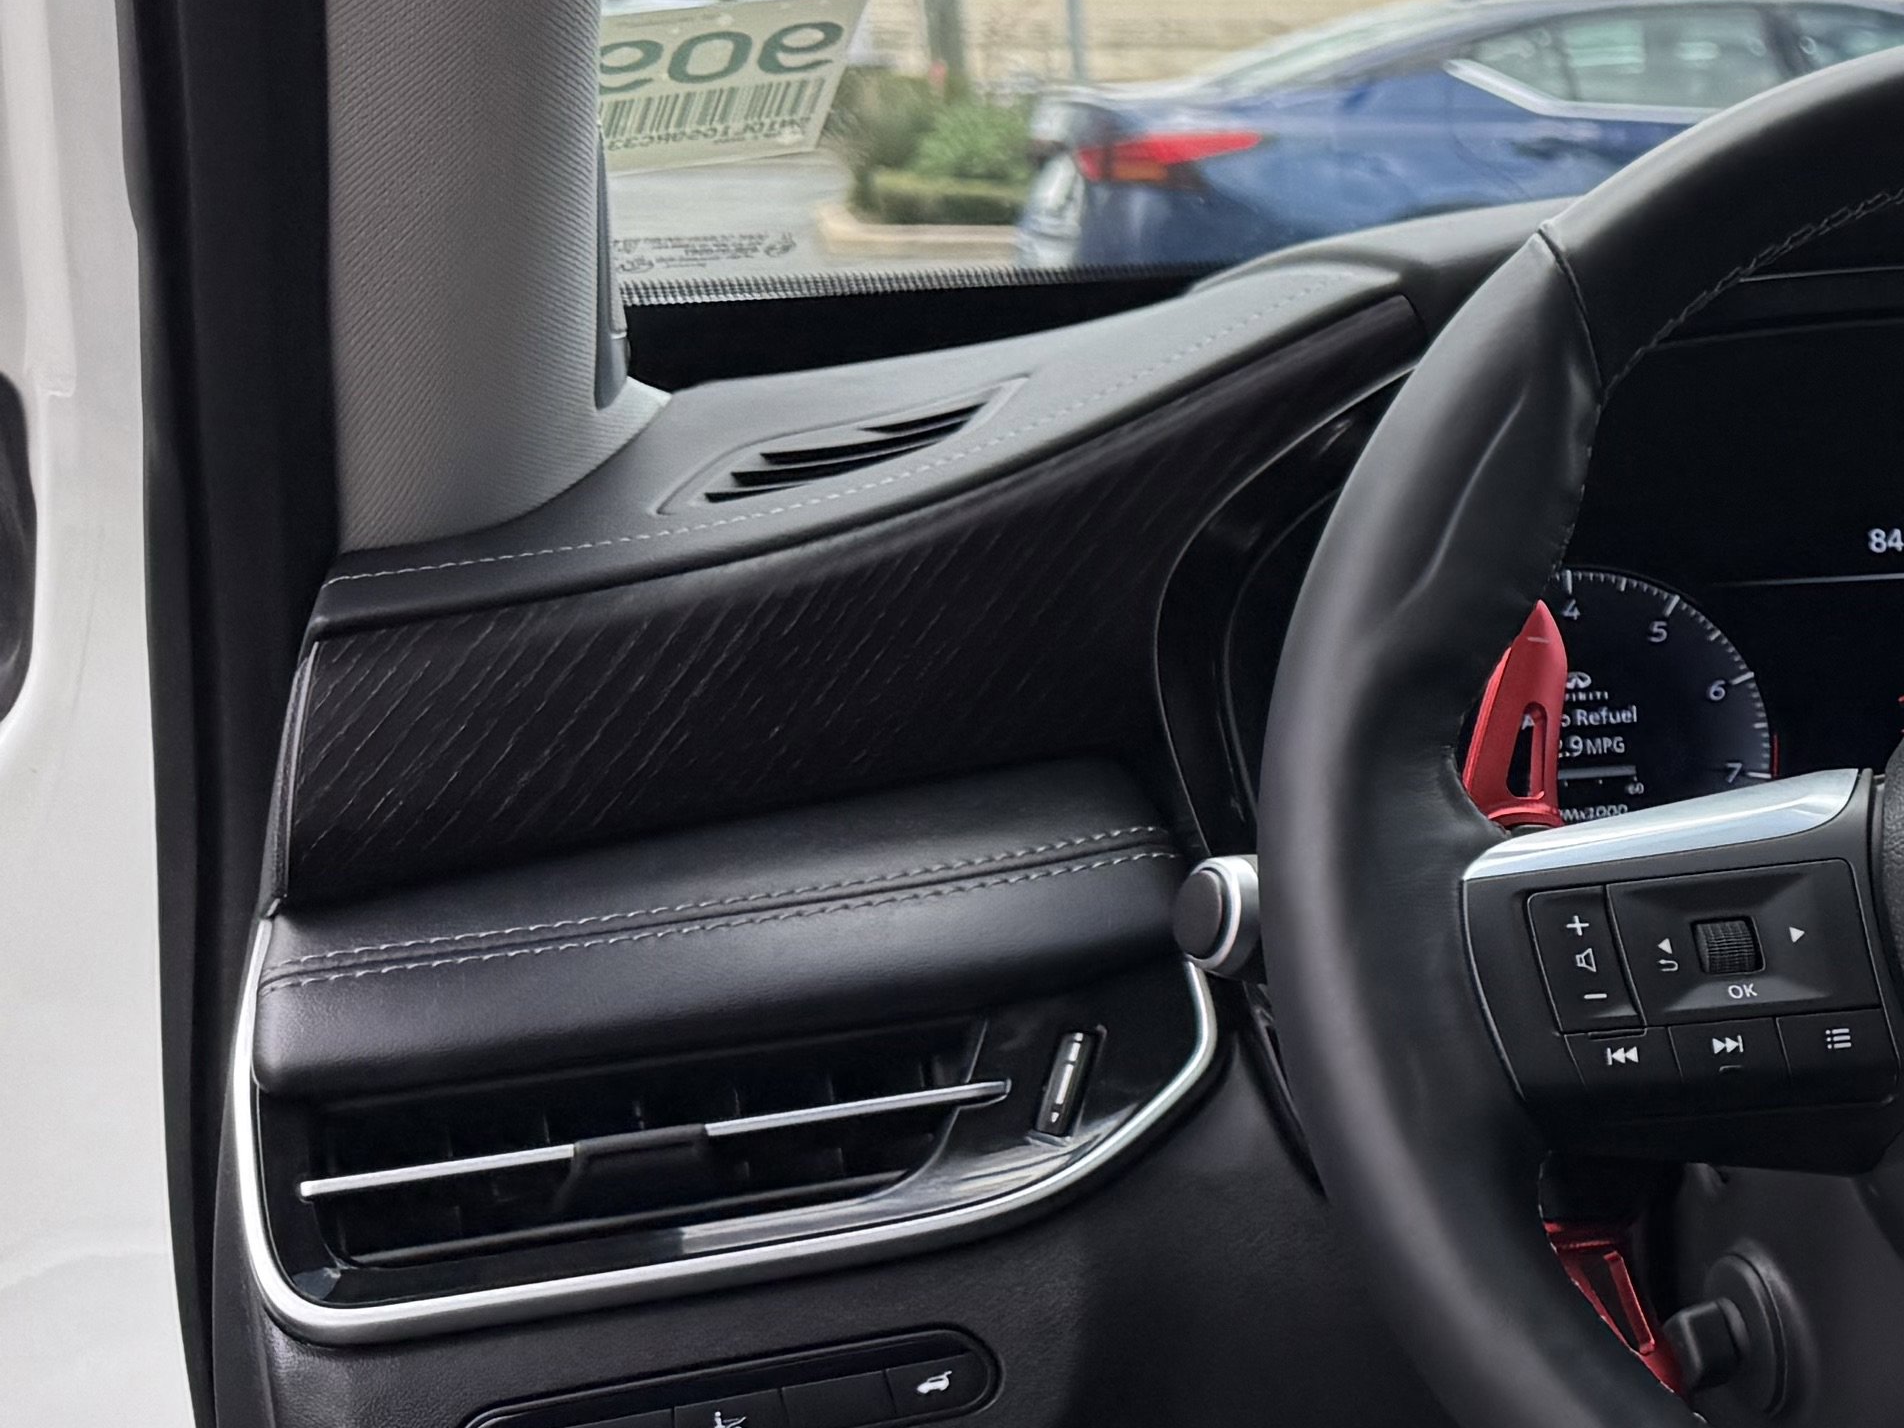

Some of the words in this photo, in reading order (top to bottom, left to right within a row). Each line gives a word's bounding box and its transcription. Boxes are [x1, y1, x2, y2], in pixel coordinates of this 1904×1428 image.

[1563, 600, 1580, 621] 4
[1650, 621, 1668, 643] 5
[1708, 680, 1726, 701] 6
[1576, 705, 1637, 726] Refuel
[1586, 737, 1625, 755] MPG
[1726, 763, 1743, 783] 7
[1728, 983, 1757, 1000] OK
